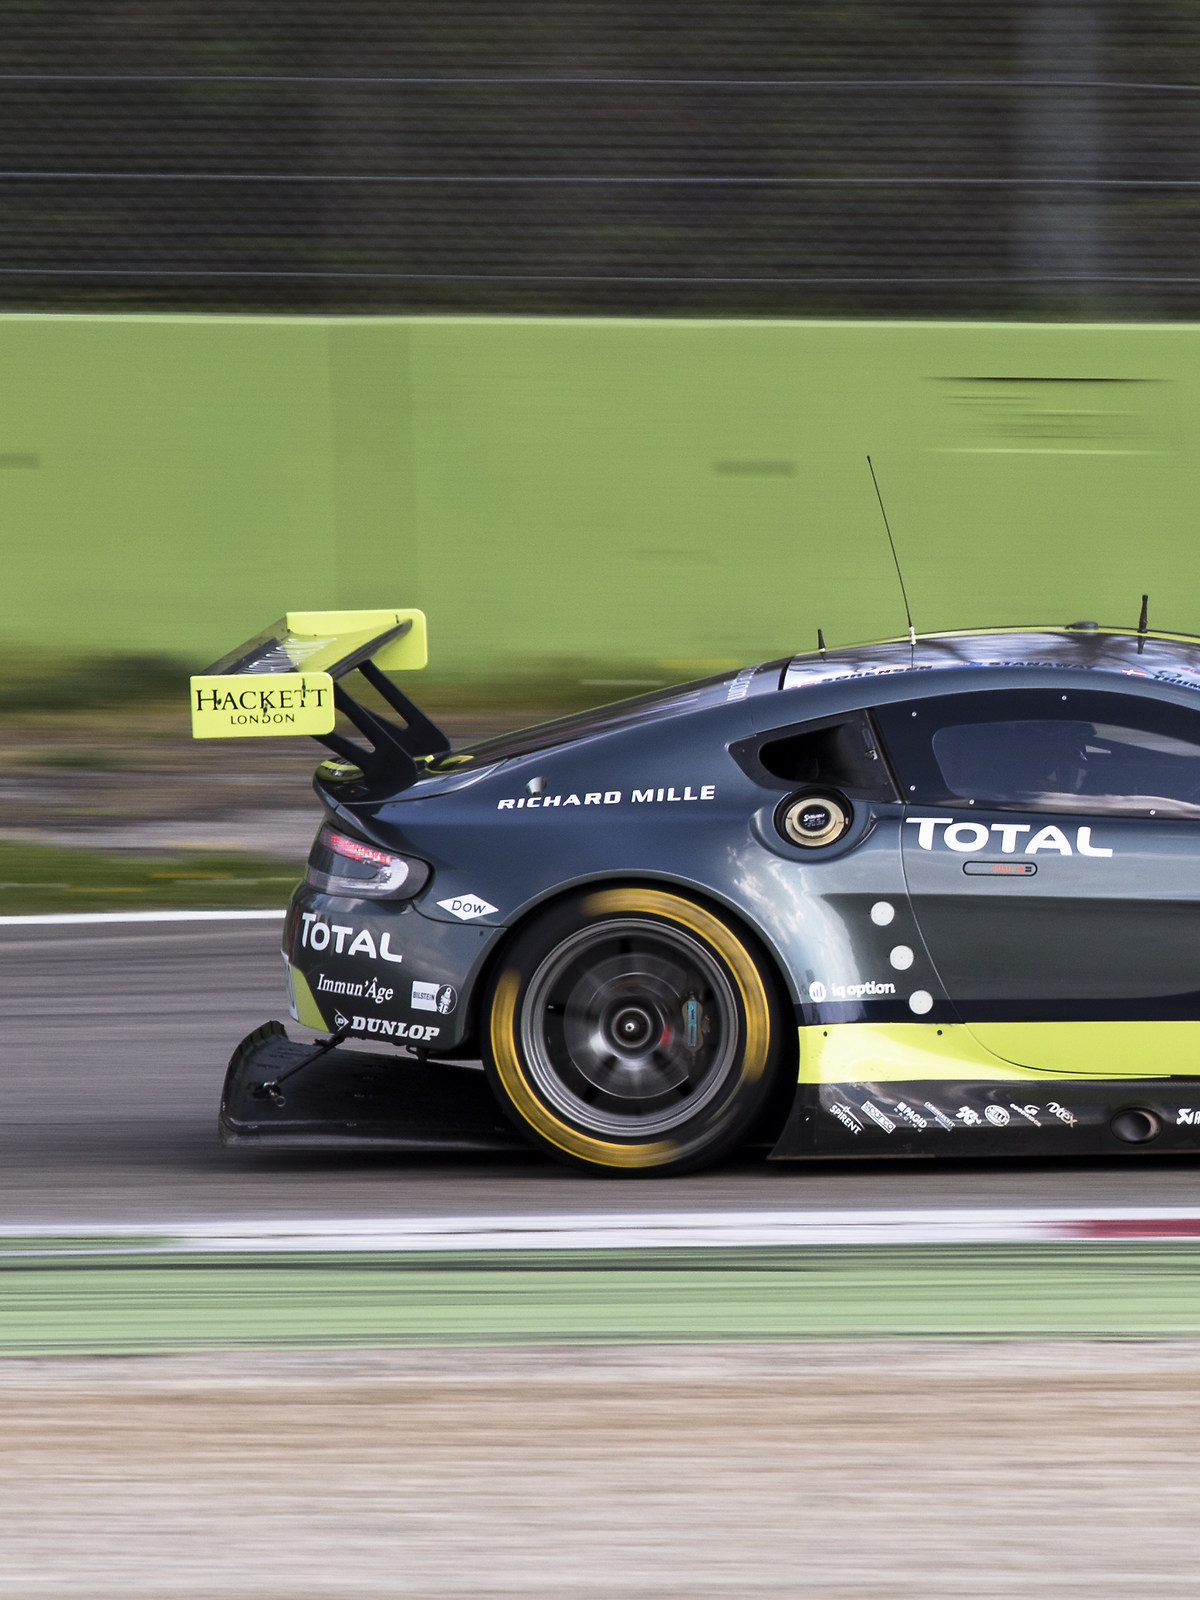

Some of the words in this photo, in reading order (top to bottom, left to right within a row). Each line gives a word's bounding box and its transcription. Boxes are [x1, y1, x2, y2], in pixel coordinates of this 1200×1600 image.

[196, 688, 328, 711] HACKETT
[230, 713, 295, 725] LONDON
[497, 791, 622, 810] RICHARD
[631, 785, 716, 803] MILLE
[906, 817, 1113, 858] TOTAL
[451, 900, 487, 914] Dow
[302, 912, 403, 963] TOTAL
[412, 991, 436, 1001] BILSTEIN
[847, 980, 896, 997] option
[351, 1016, 440, 1041] DUNLOP
[829, 1104, 862, 1135] SPIRENT
[902, 1106, 928, 1129] PAGID
